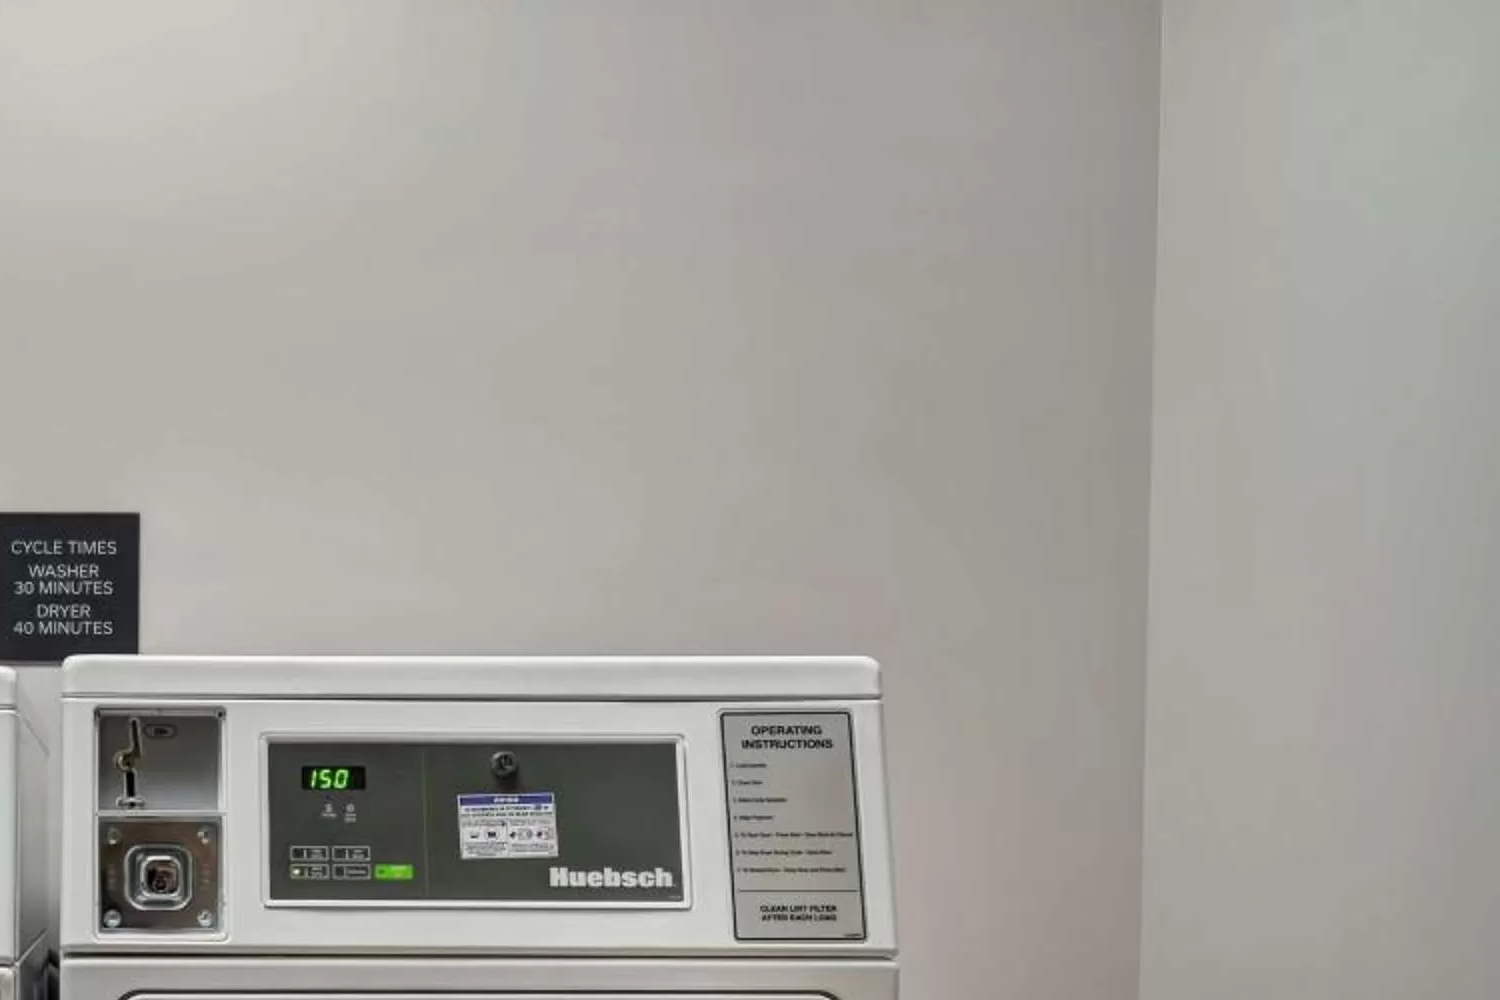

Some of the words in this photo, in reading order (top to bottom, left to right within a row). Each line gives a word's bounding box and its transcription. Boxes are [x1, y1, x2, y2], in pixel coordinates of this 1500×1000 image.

[11, 540, 63, 555] CYCLE
[68, 540, 117, 555] TIMES
[28, 564, 100, 578] WASHER
[14, 581, 35, 595] 30
[39, 581, 114, 595] MINUTES
[37, 604, 92, 618] DRYER
[13, 621, 35, 635] 40
[39, 621, 114, 635] MINUTES
[751, 725, 823, 735] OPERATING
[741, 739, 834, 749] INSTRUCTIONS
[311, 769, 349, 788] 150
[549, 867, 673, 887] Huebsch
